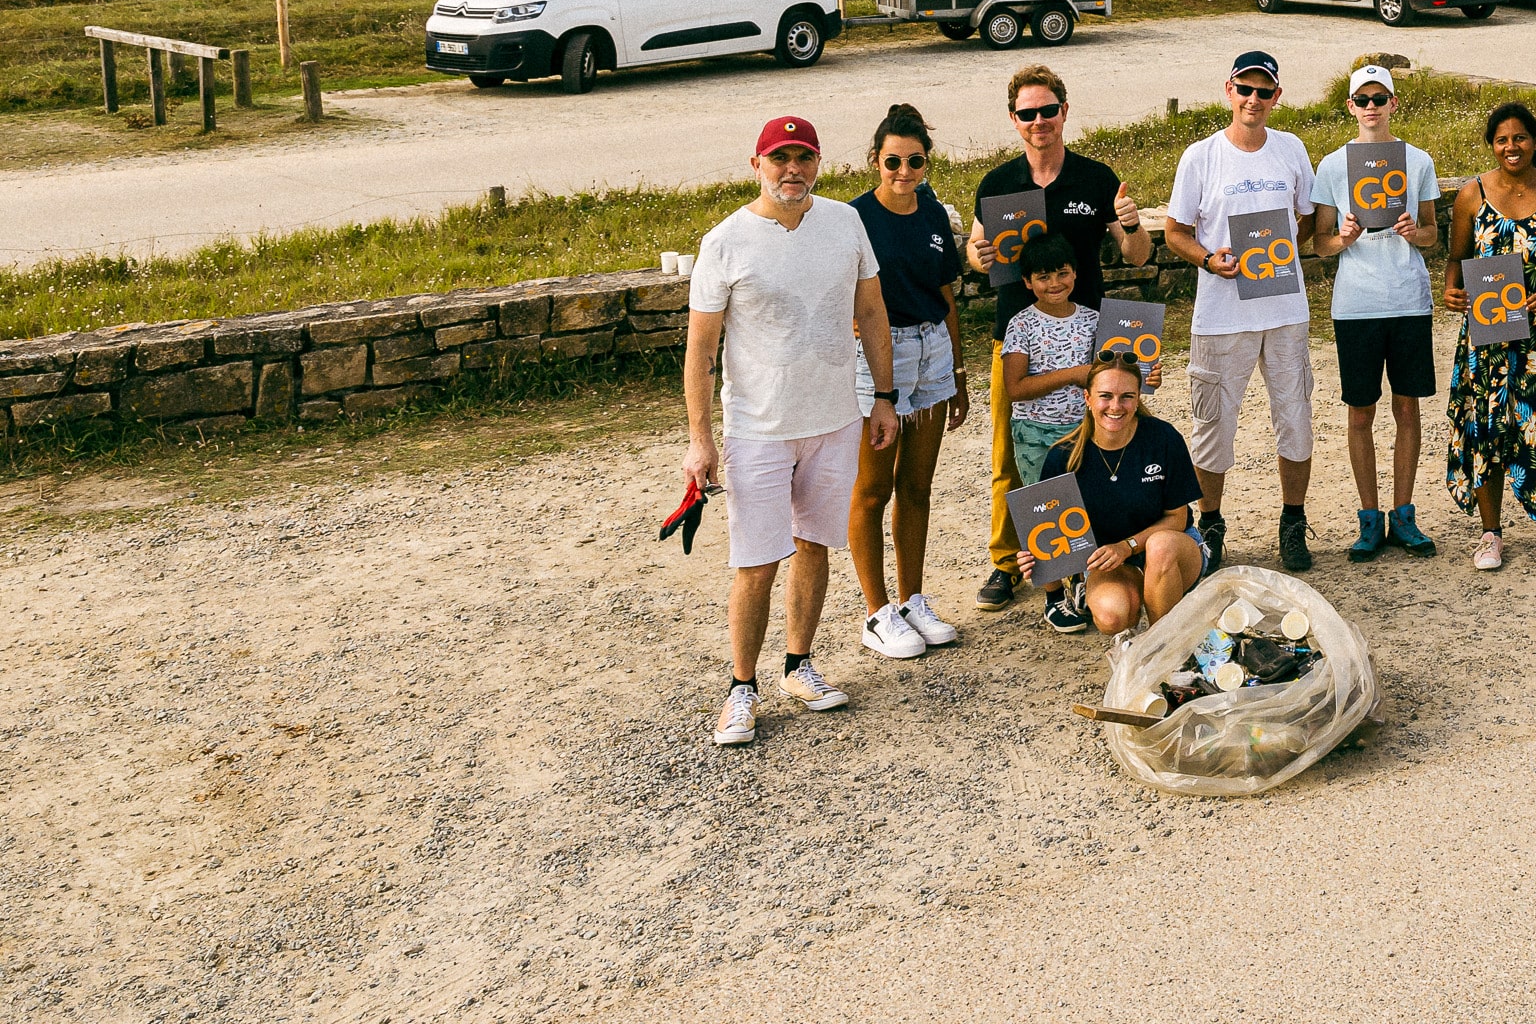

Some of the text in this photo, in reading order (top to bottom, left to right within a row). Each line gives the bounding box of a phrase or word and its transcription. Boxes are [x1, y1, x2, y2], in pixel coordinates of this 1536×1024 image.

[1223, 178, 1288, 196] adidas
[1353, 170, 1407, 210] GO
[1239, 238, 1295, 281] GO
[1472, 282, 1527, 326] GO
[1027, 506, 1091, 561] GO
